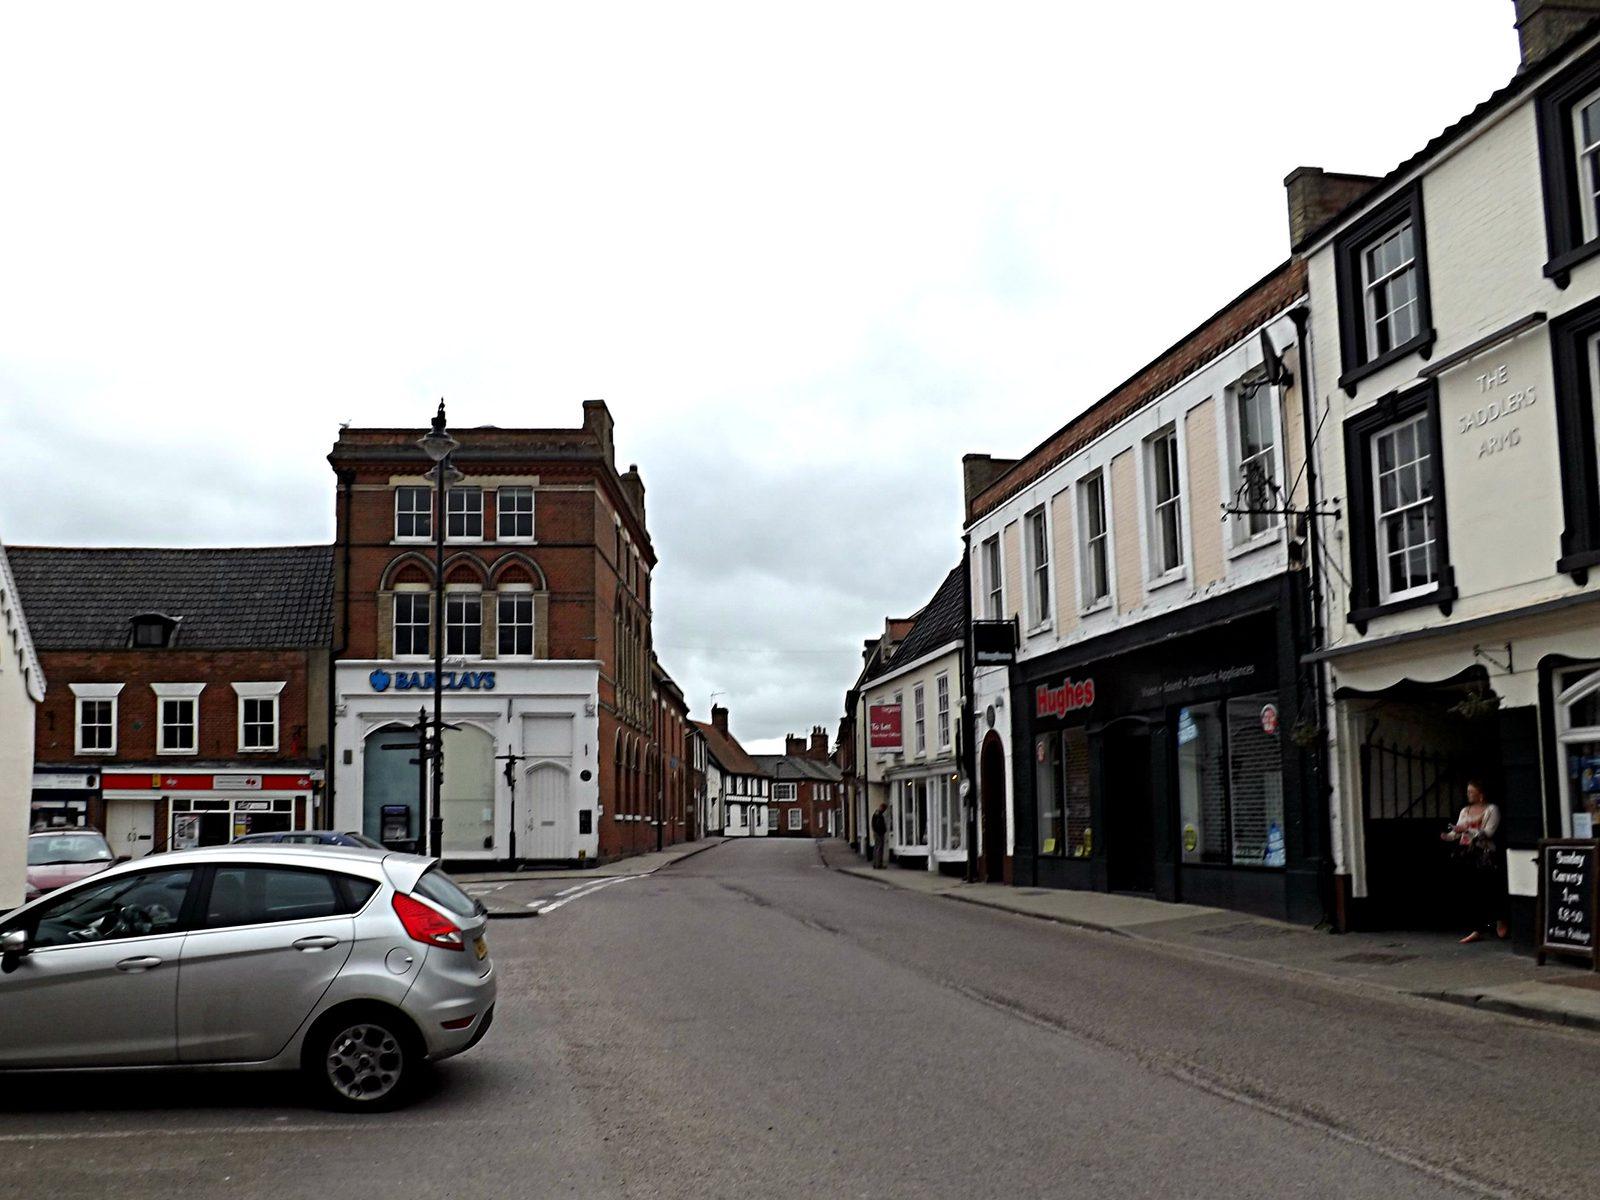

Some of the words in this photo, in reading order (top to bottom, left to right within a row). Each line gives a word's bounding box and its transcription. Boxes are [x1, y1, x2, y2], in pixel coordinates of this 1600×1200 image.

[1476, 364, 1508, 393] THE
[1458, 385, 1537, 435] SADDLERS
[1478, 427, 1521, 459] ARMS
[395, 671, 496, 690] BARCLAYS
[1036, 677, 1095, 719] Hughes
